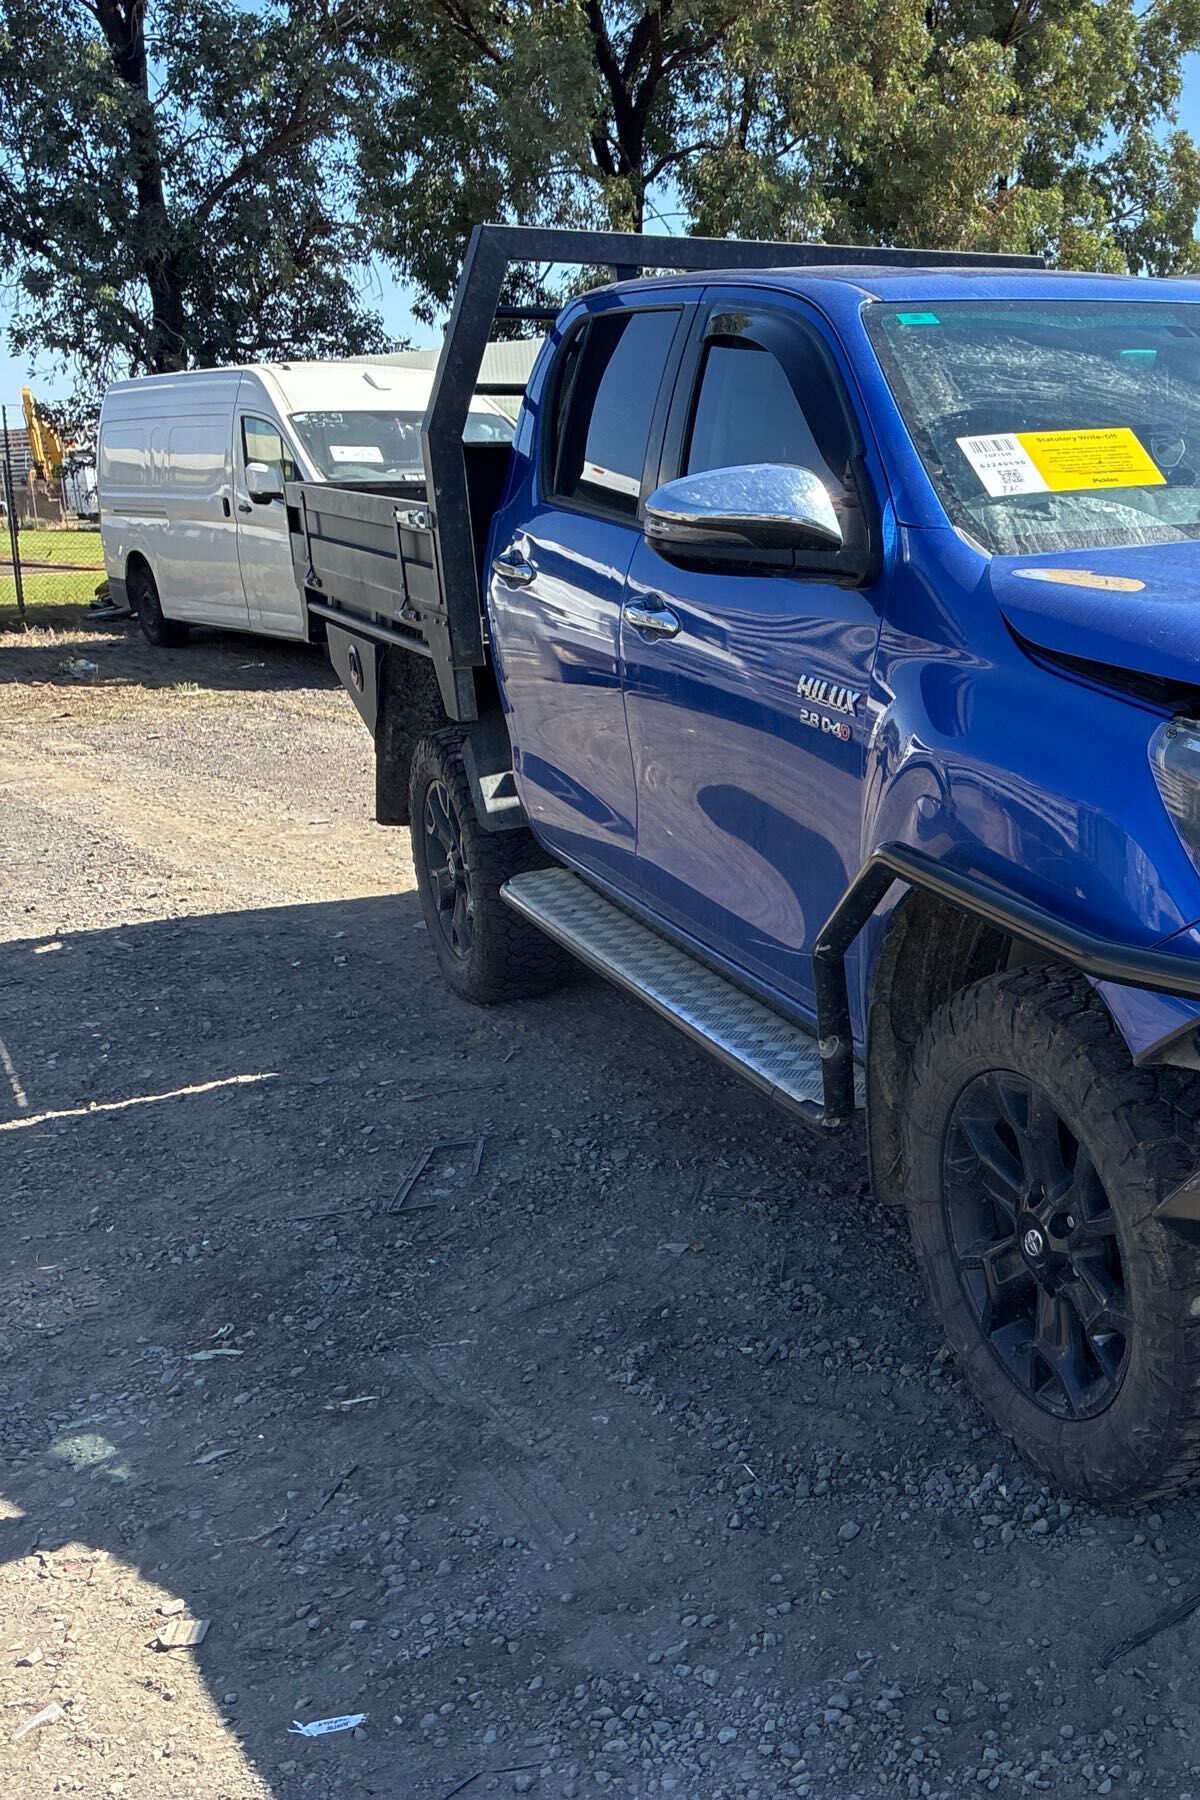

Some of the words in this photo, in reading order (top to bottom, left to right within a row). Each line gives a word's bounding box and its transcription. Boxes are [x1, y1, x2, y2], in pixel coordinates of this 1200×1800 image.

[1036, 435, 1076, 443] Statutory
[1079, 433, 1118, 441] Write-Off
[797, 674, 861, 717] HILUX
